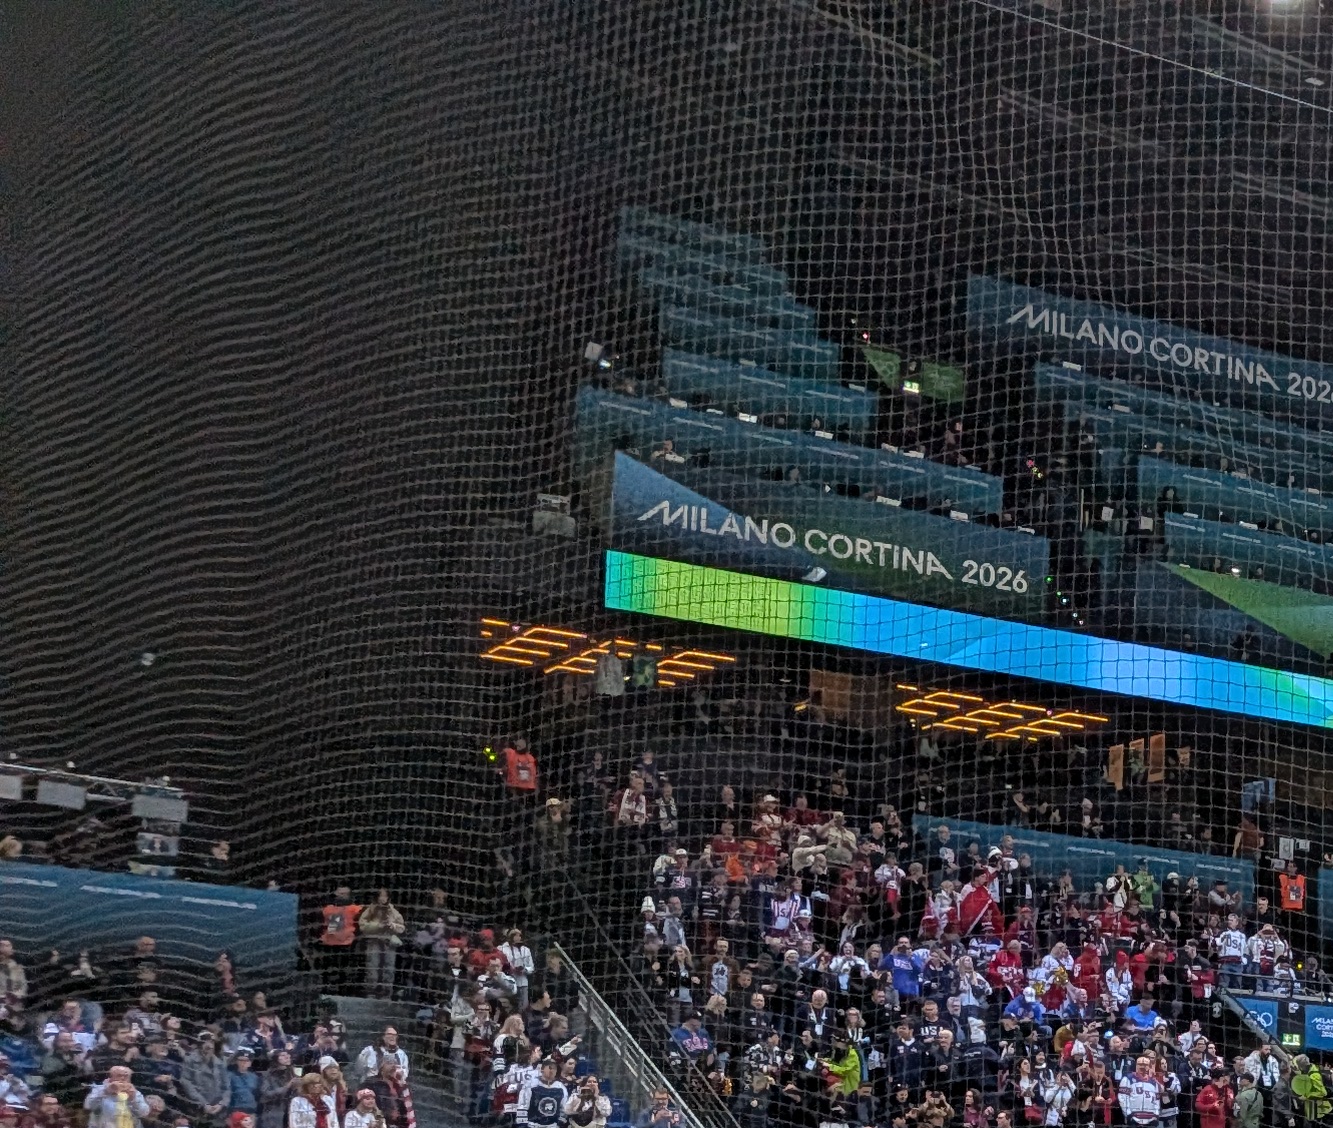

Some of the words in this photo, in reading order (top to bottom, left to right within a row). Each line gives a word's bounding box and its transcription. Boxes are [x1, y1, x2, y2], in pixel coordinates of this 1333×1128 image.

[1006, 304, 1142, 354] MILANO
[1149, 337, 1281, 392] CORTINA
[637, 500, 797, 549] MILANO
[804, 529, 954, 581] CORTINA
[961, 559, 1029, 594] 2026
